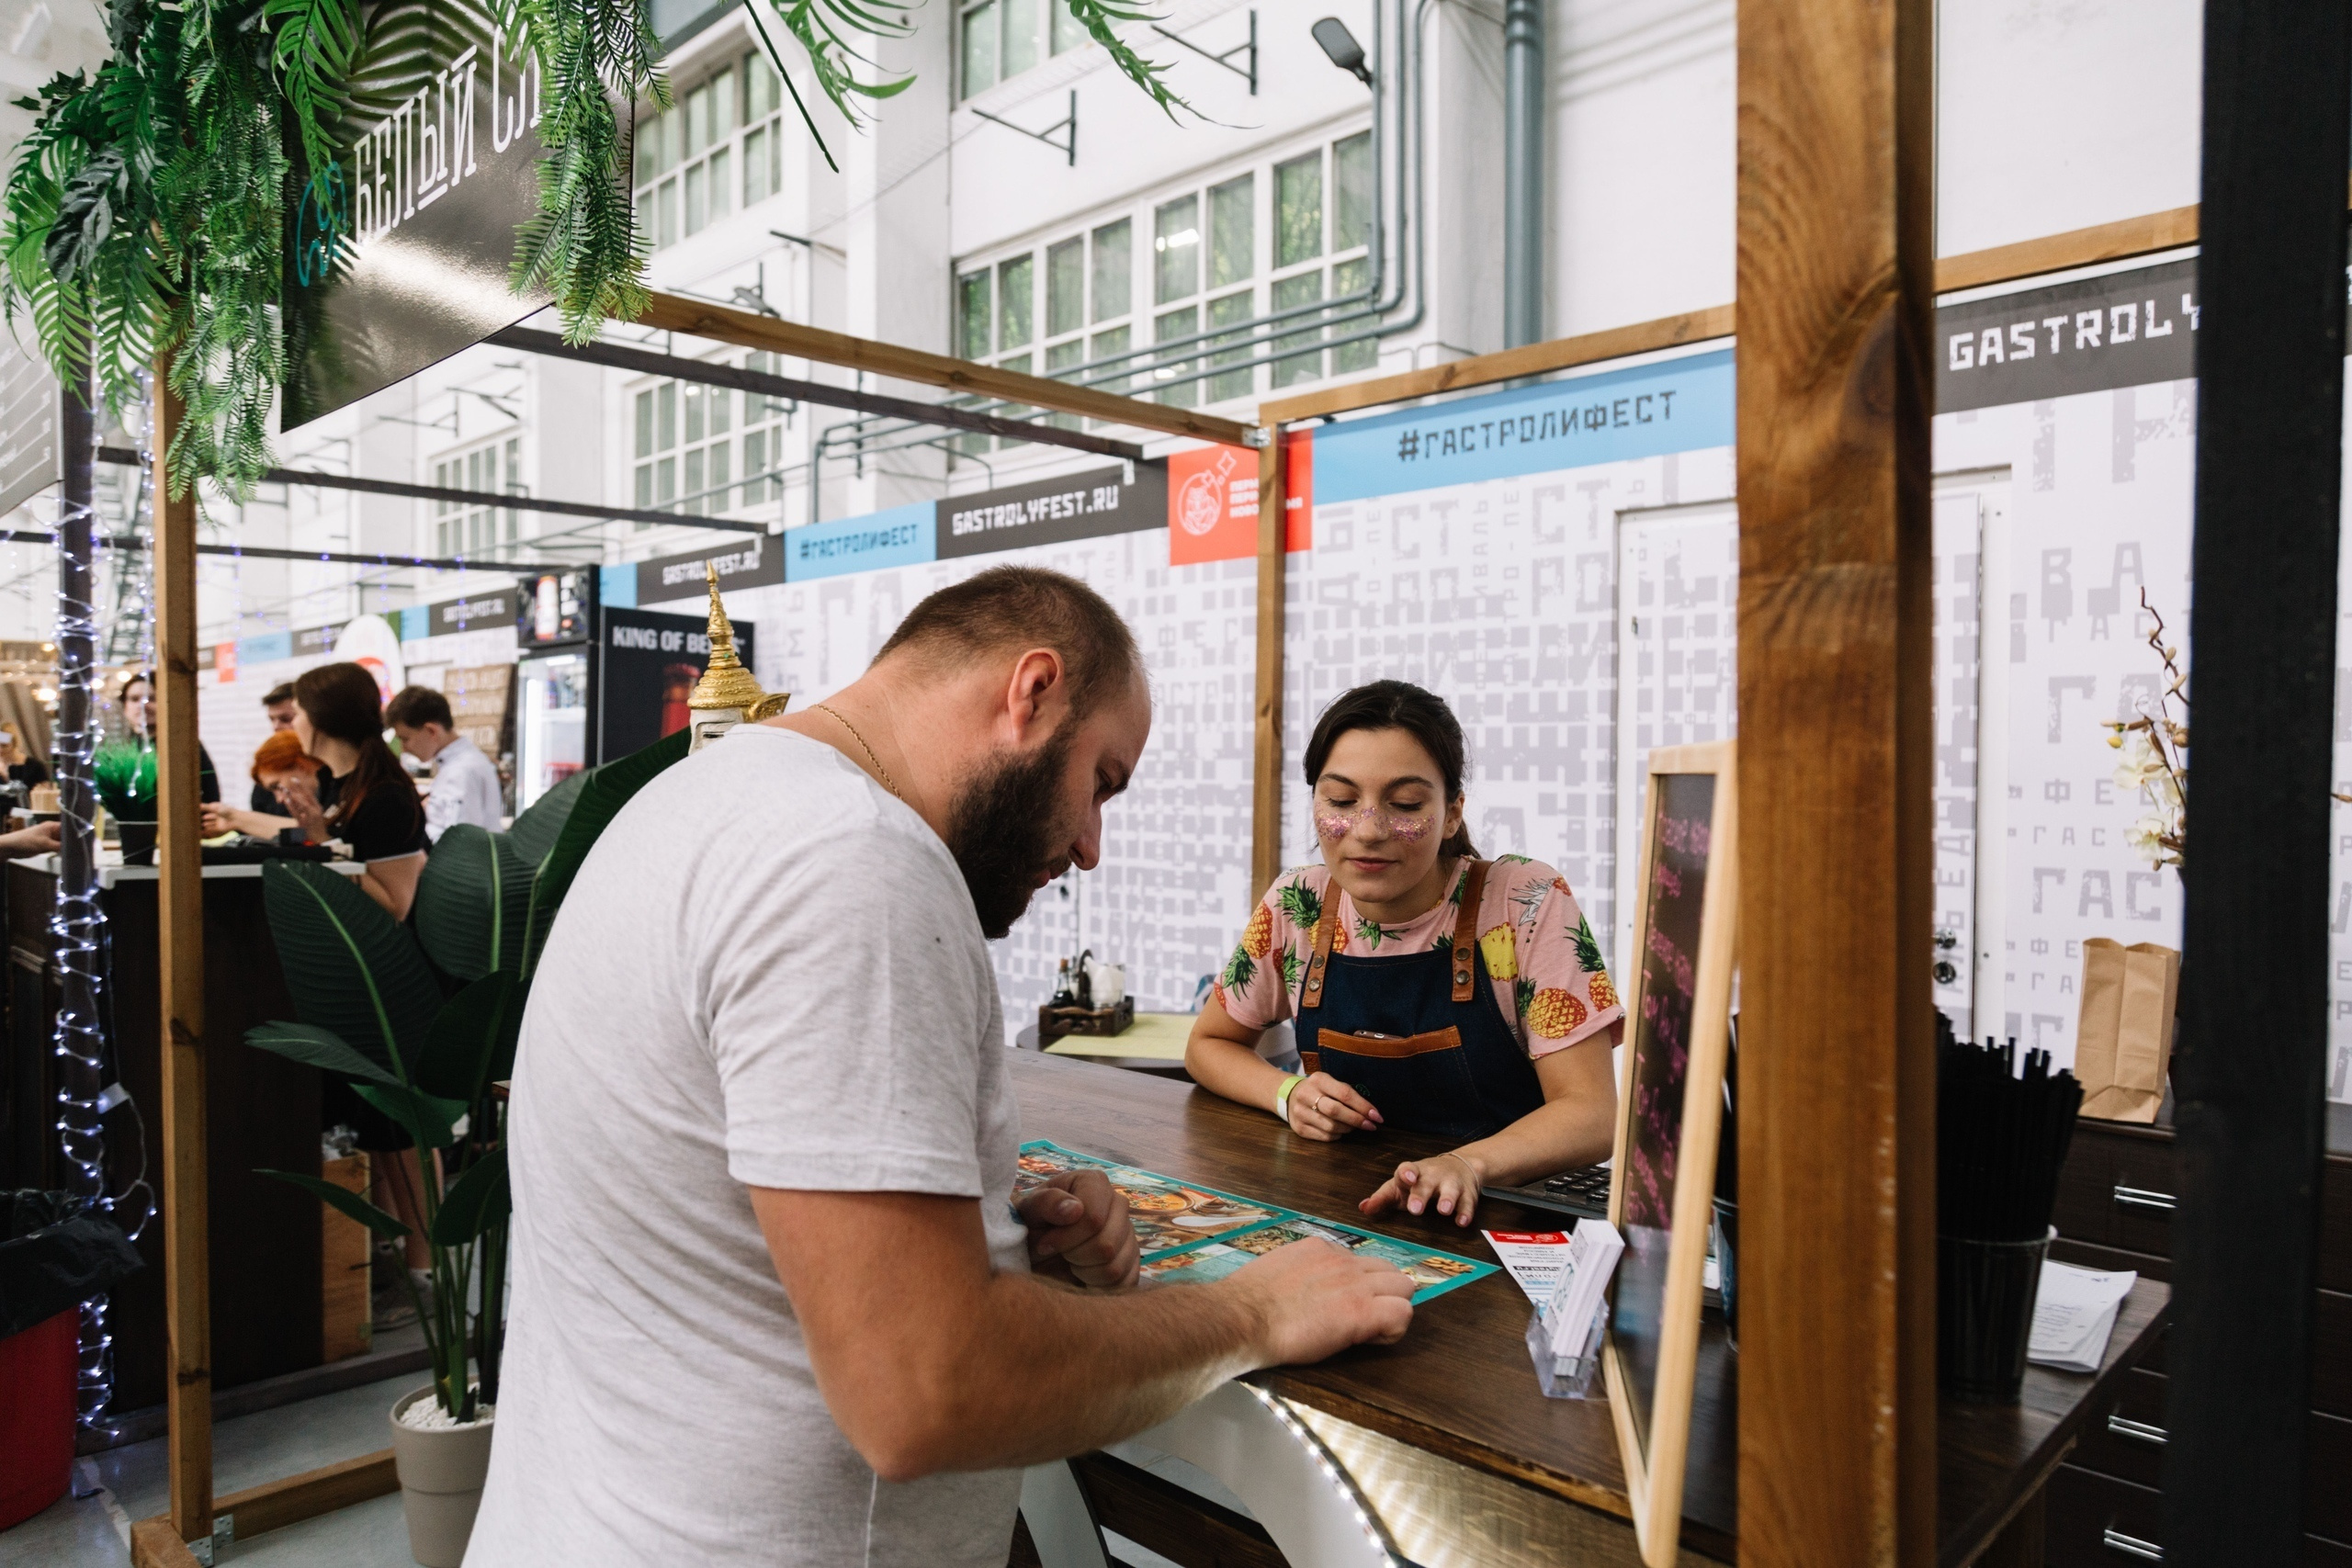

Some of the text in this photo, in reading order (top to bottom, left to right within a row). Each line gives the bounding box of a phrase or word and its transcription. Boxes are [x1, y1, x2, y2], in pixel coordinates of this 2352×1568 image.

[353, 44, 478, 246] БЕЛЫЙ
[1397, 389, 1678, 461] #ГАСТРОЛИФЕСТ
[952, 484, 1119, 536] GASTROLYFEST.RU
[799, 523, 918, 560] #ГАСТРОЛИФЕСТ
[662, 550, 761, 585] GASTROLFEST.RU
[612, 625, 658, 650] KING
[661, 629, 685, 652] OF
